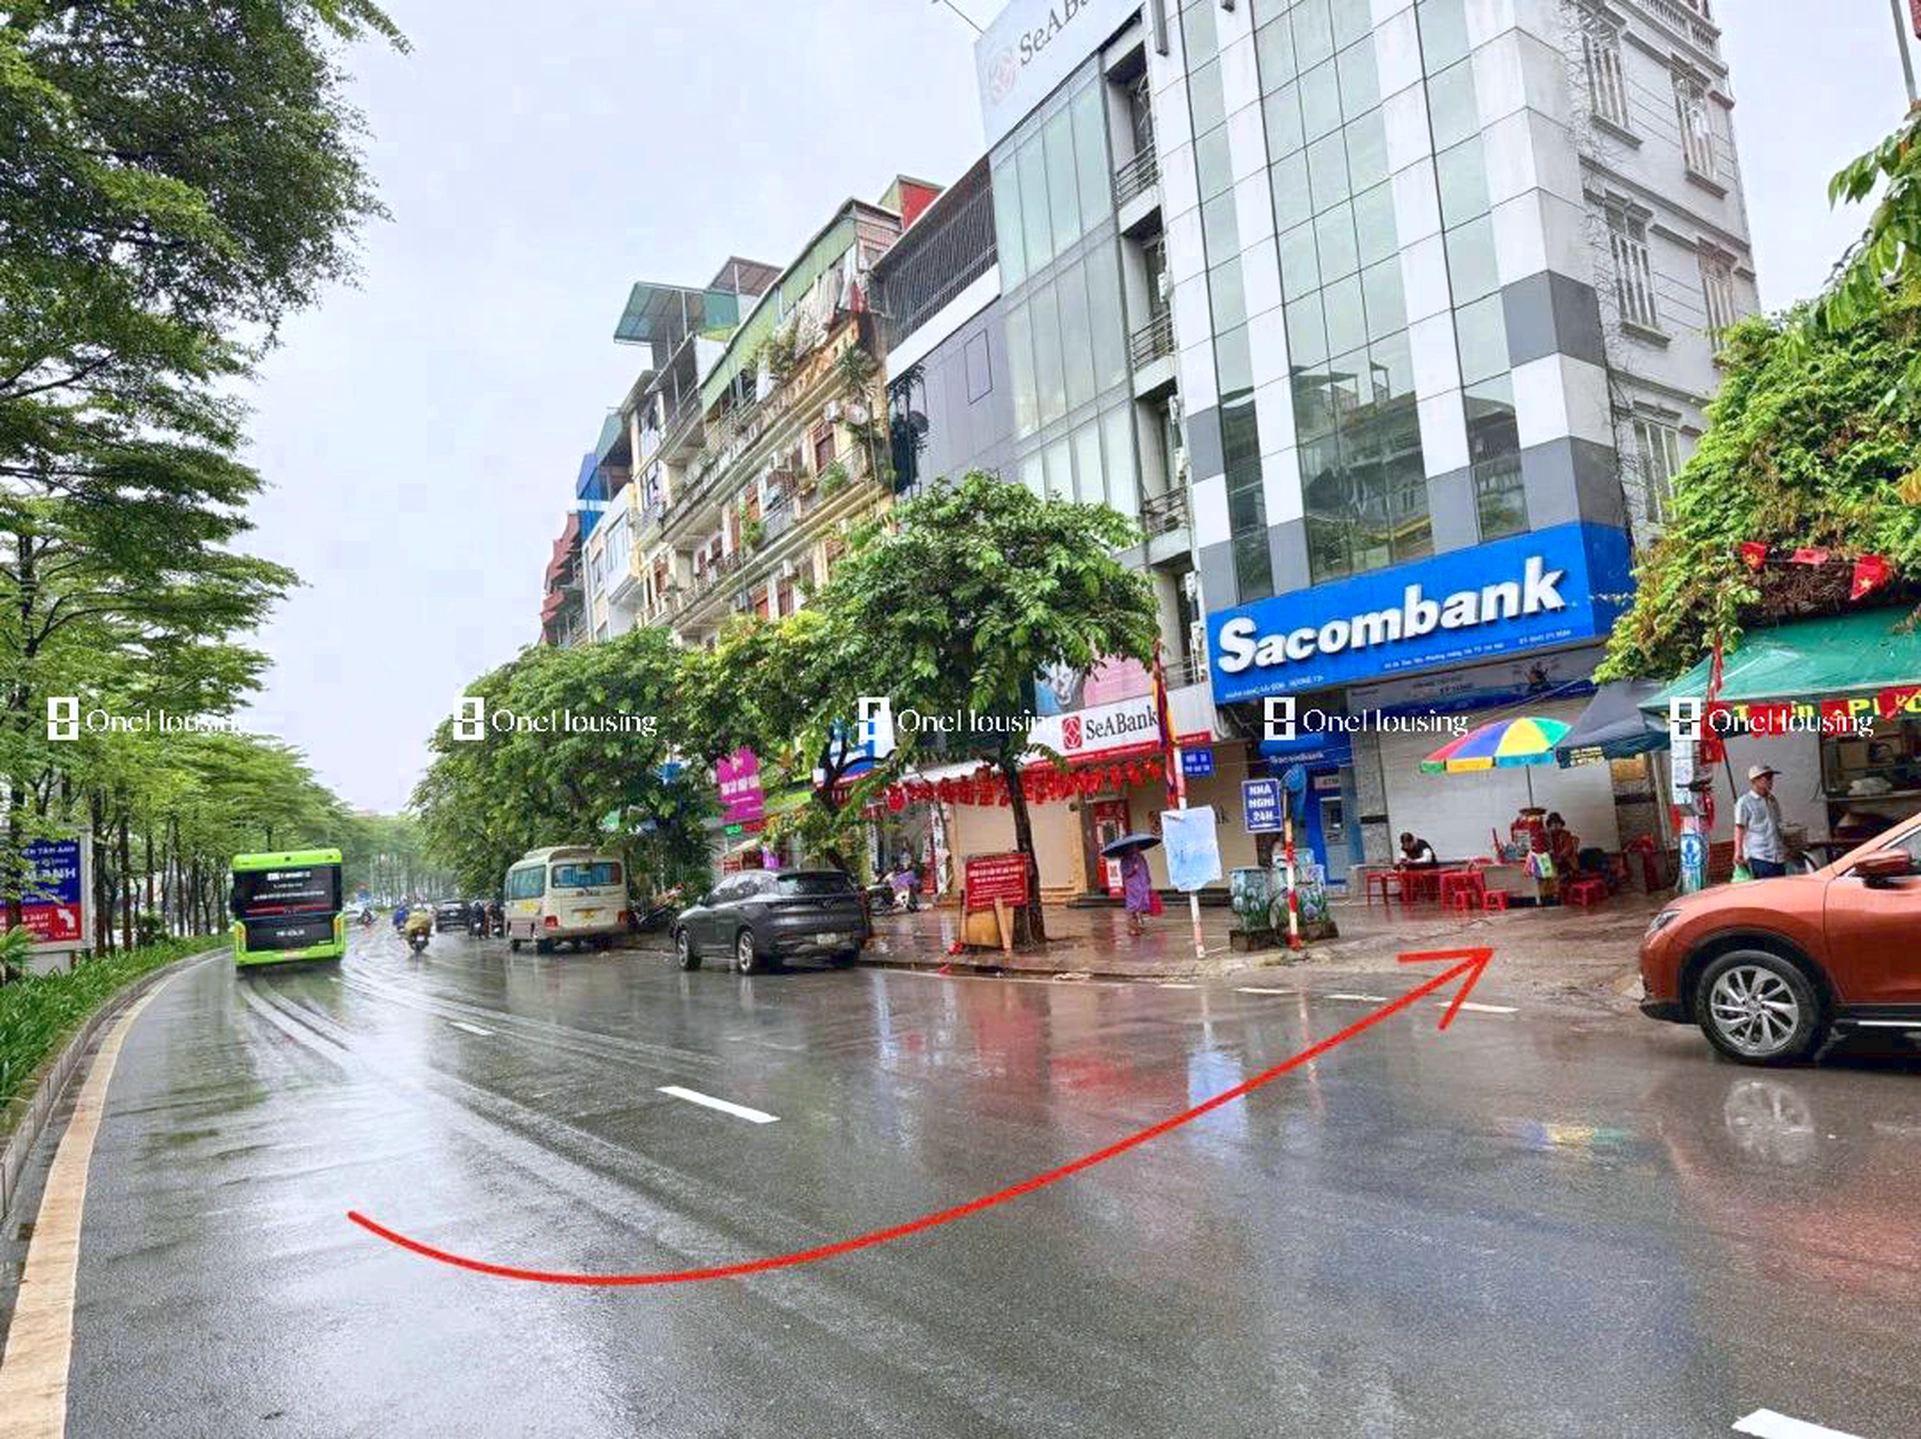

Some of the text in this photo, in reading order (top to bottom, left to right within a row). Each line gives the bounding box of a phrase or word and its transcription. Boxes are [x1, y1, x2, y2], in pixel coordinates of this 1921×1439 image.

[1019, 0, 1091, 66] SeAB
[1217, 556, 1566, 674] Sacombank
[1085, 704, 1159, 740] SeABank
[1248, 782, 1273, 796] NHÀ
